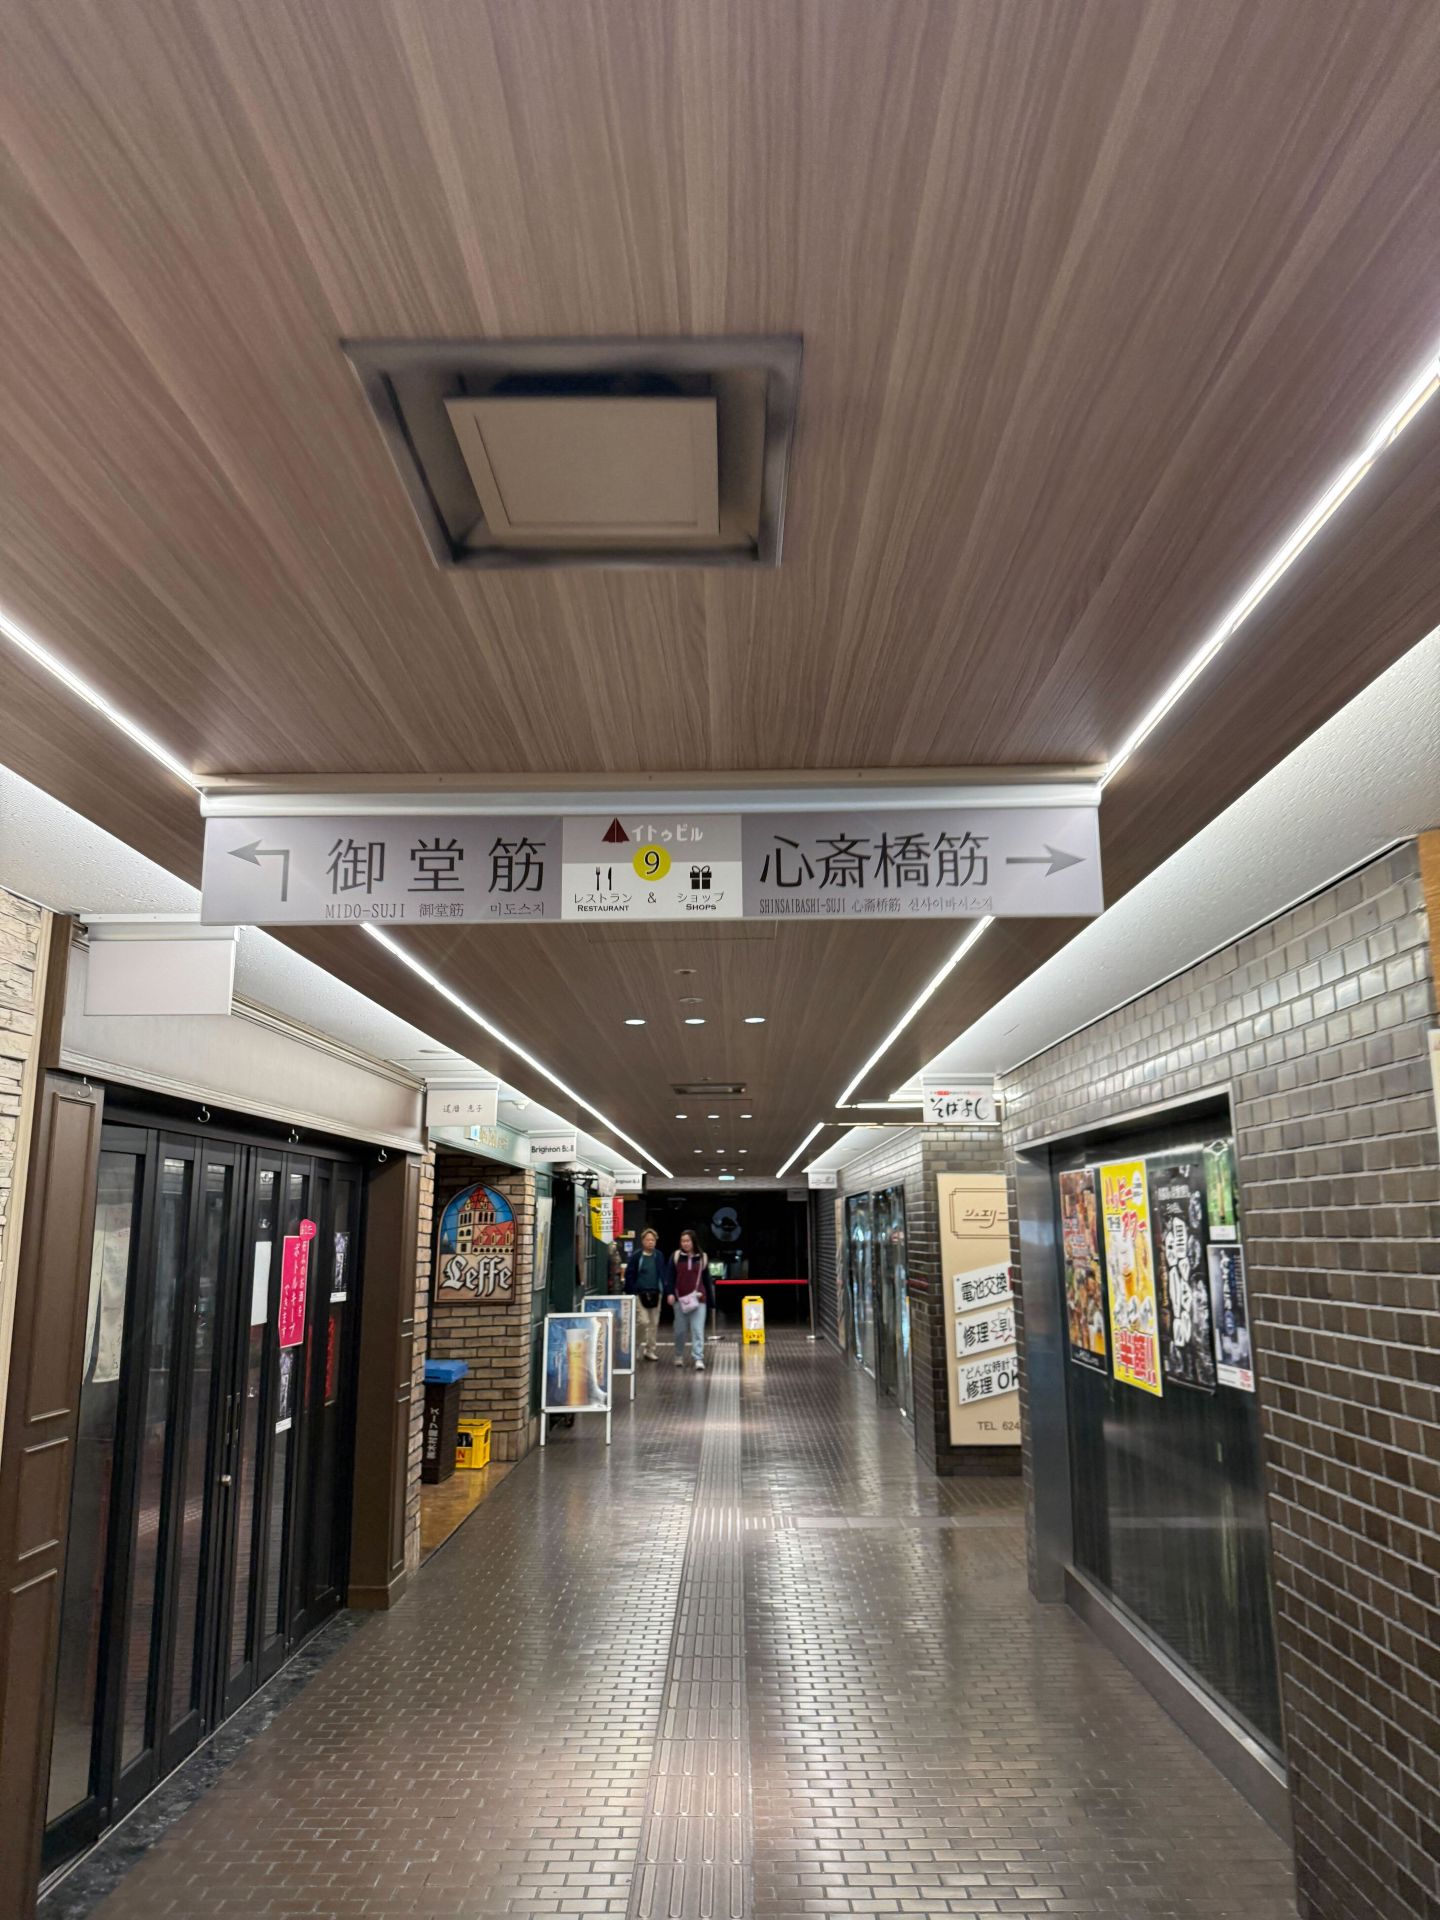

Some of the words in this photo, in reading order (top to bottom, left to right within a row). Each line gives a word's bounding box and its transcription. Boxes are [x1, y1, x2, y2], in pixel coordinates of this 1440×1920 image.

[632, 823, 704, 842] イトゥビル
[326, 837, 546, 894] 御堂筋
[644, 851, 660, 875] 9
[759, 831, 989, 889] 心斎橋筋
[490, 901, 544, 917] 미도스지
[574, 892, 632, 904] レストラン
[647, 892, 657, 904] &
[677, 891, 725, 903] ショップ
[759, 898, 846, 914] SHINSAIBASHI-SUJI
[325, 903, 406, 918] MIDO-SUJI
[418, 903, 464, 918] 御堂筋
[930, 1097, 990, 1120] そばよし
[440, 1254, 512, 1297] Leffe
[961, 1273, 1008, 1302] 電池交換
[963, 1321, 989, 1347] 修理
[966, 1376, 993, 1399] 修理
[977, 1421, 997, 1431] TEL
